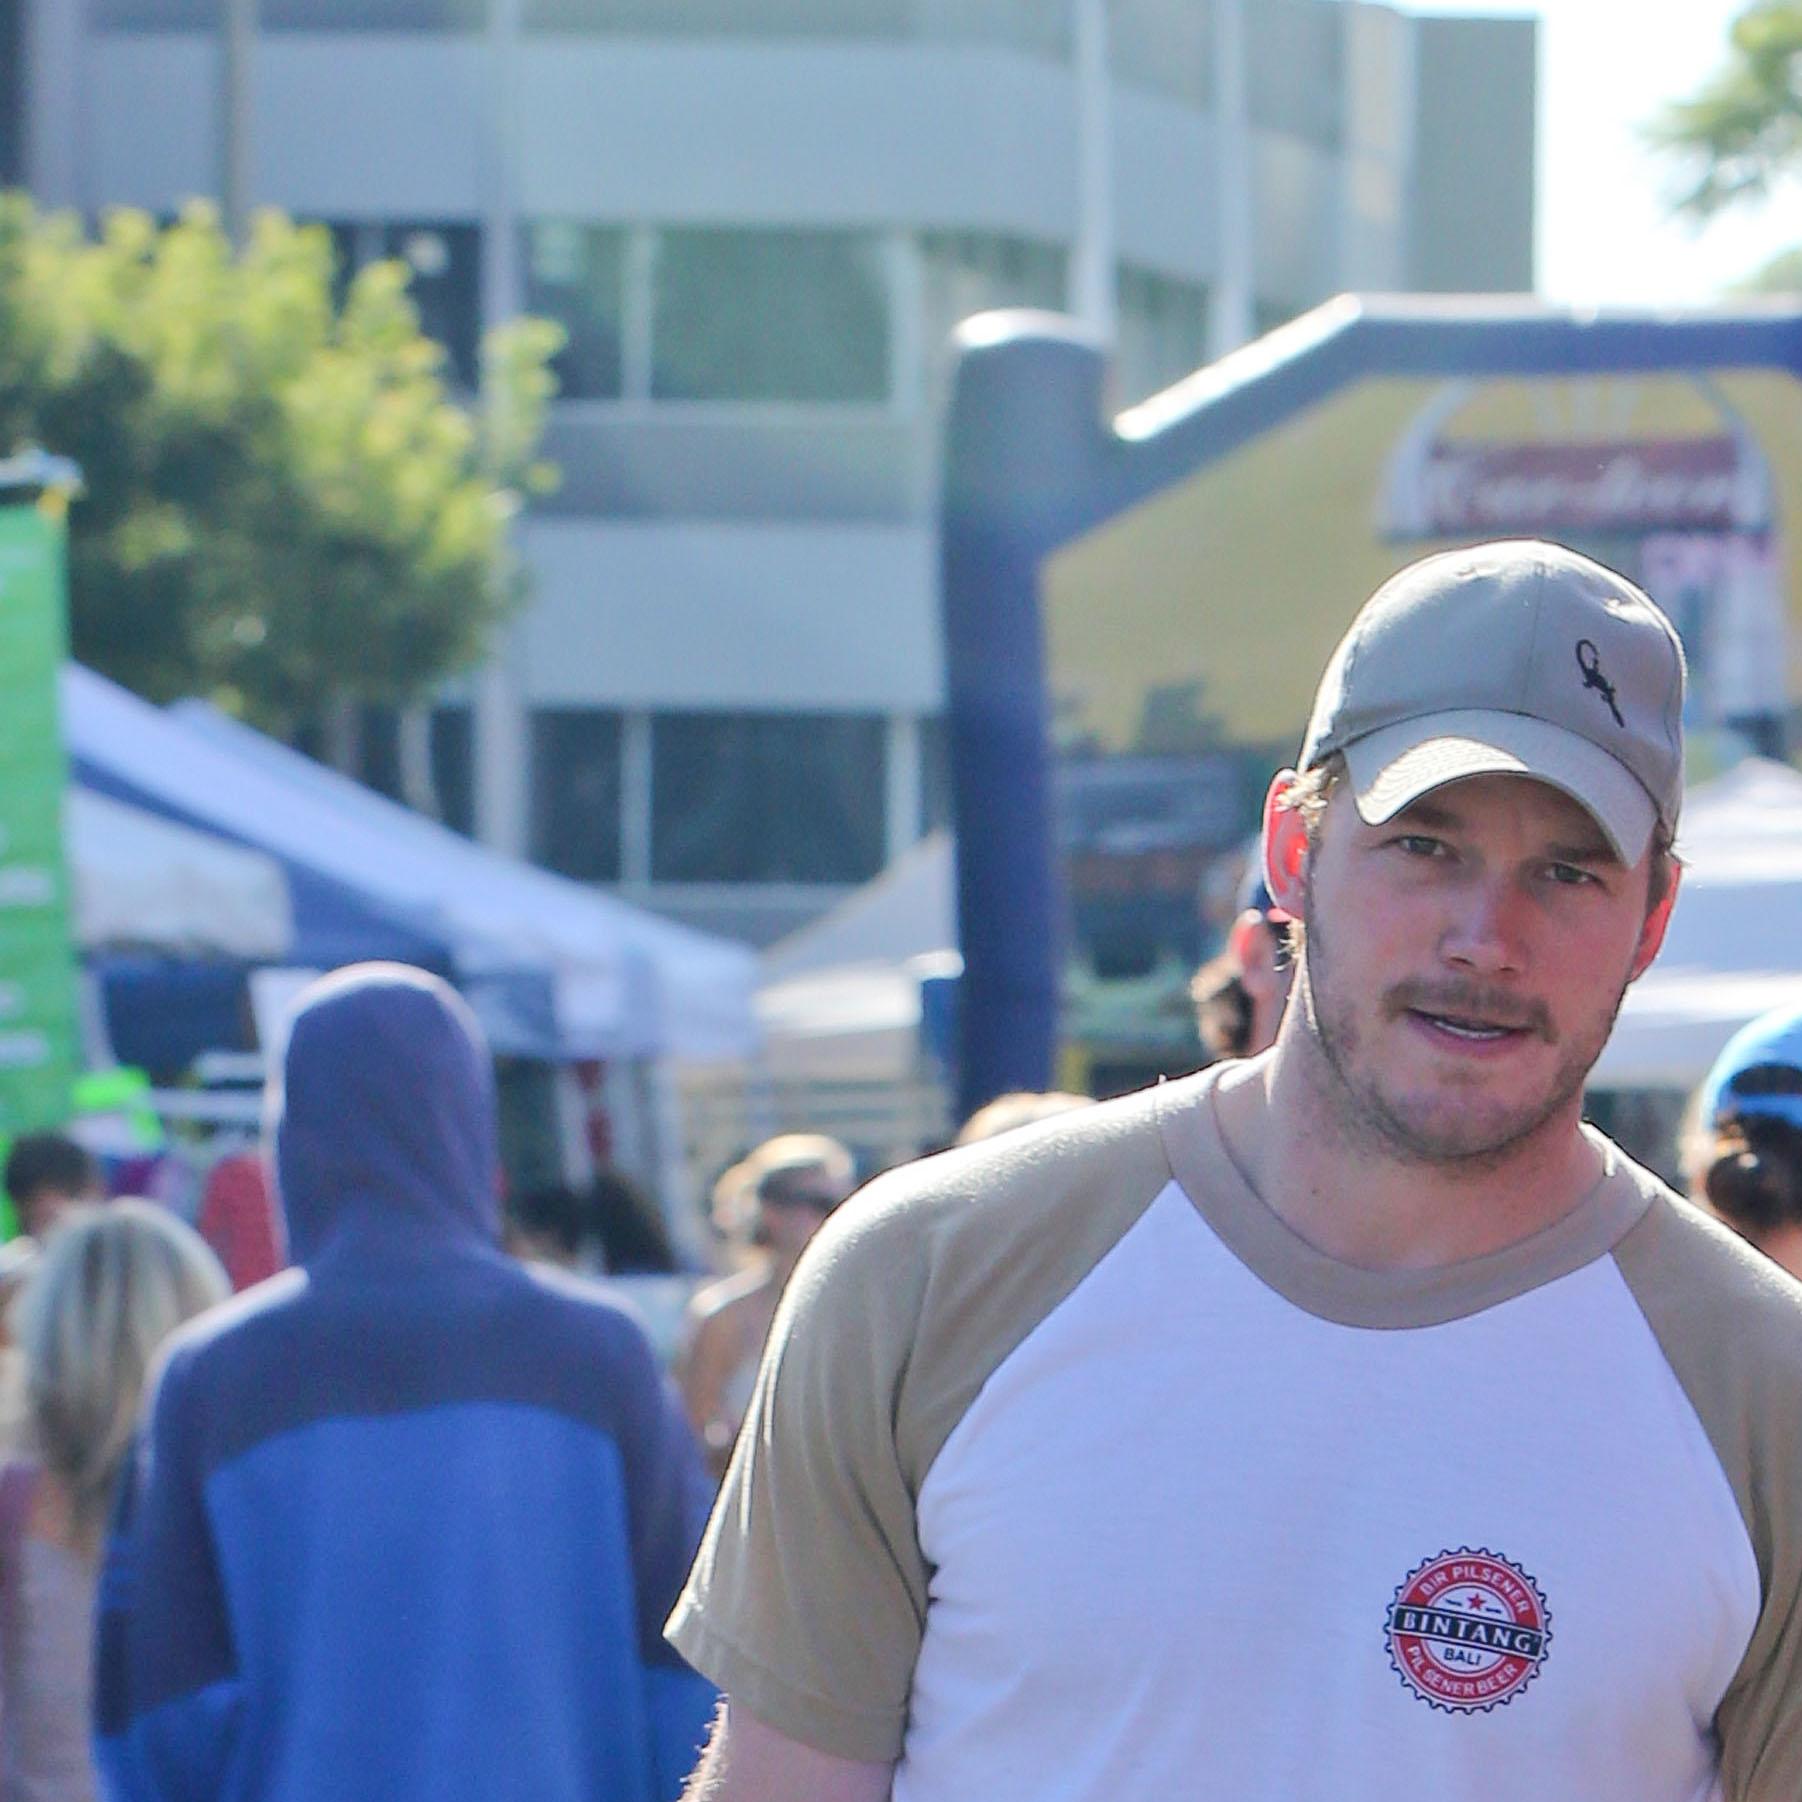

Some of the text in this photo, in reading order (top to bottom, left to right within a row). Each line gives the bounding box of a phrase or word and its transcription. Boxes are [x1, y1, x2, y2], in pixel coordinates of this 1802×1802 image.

[1418, 1565, 1531, 1614] BIR PILSENER
[1403, 1612, 1533, 1652] BINTANG
[1407, 1645, 1519, 1697] PILSENER BEER
[1444, 1647, 1482, 1666] BALI
